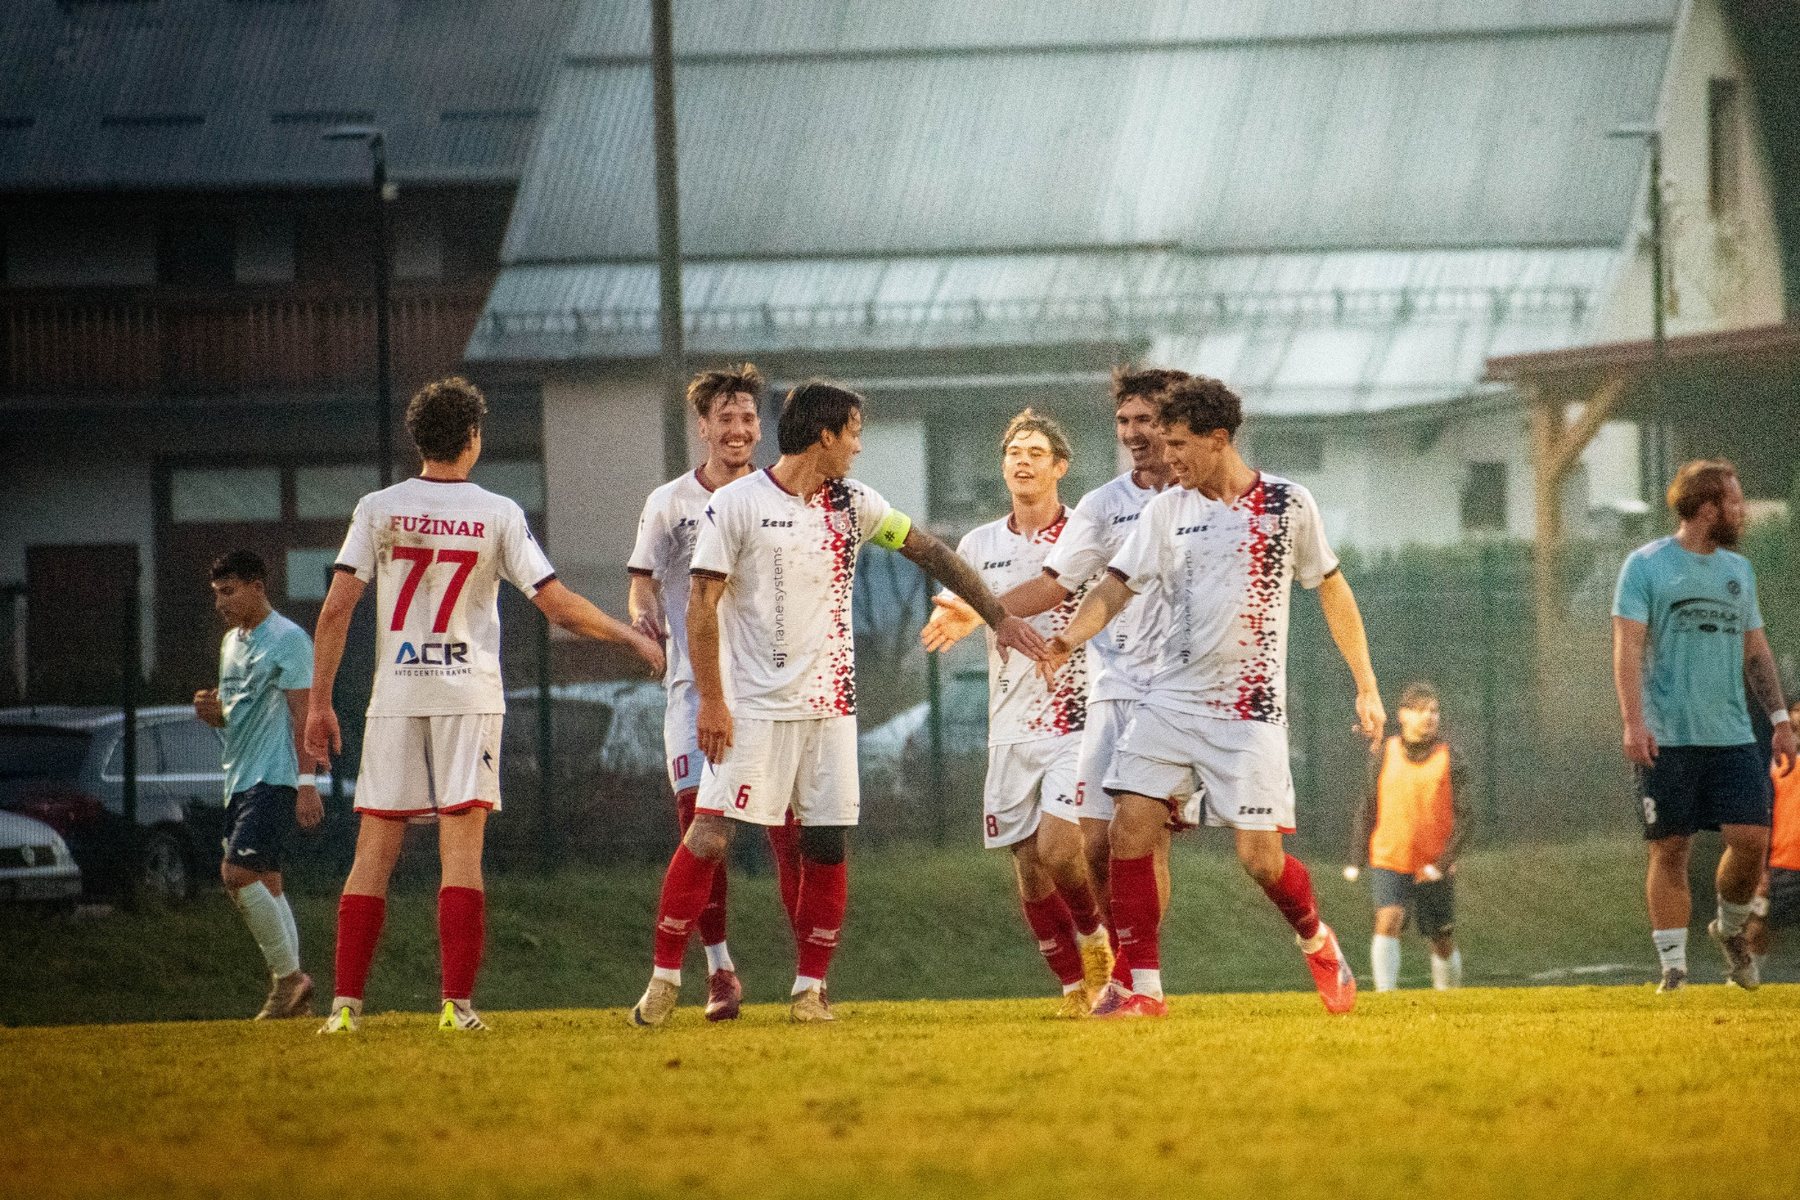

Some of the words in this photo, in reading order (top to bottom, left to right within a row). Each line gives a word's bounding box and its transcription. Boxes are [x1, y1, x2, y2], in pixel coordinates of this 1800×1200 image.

[389, 514, 486, 539] FUŽINAR
[678, 517, 700, 527] Ze
[761, 518, 793, 528] Zeus
[1112, 512, 1140, 525] Zeus
[1176, 525, 1208, 536] Zeus
[774, 547, 788, 600] systems
[983, 559, 1012, 570] Zeus
[389, 546, 479, 634] 77
[775, 606, 785, 641] ravne
[395, 641, 469, 666] ACR
[446, 667, 472, 676] RAVNE
[672, 754, 689, 782] 10
[734, 784, 752, 809] 6
[1056, 794, 1073, 805] Ze
[1239, 805, 1273, 815] Zeus
[986, 814, 999, 838] 8
